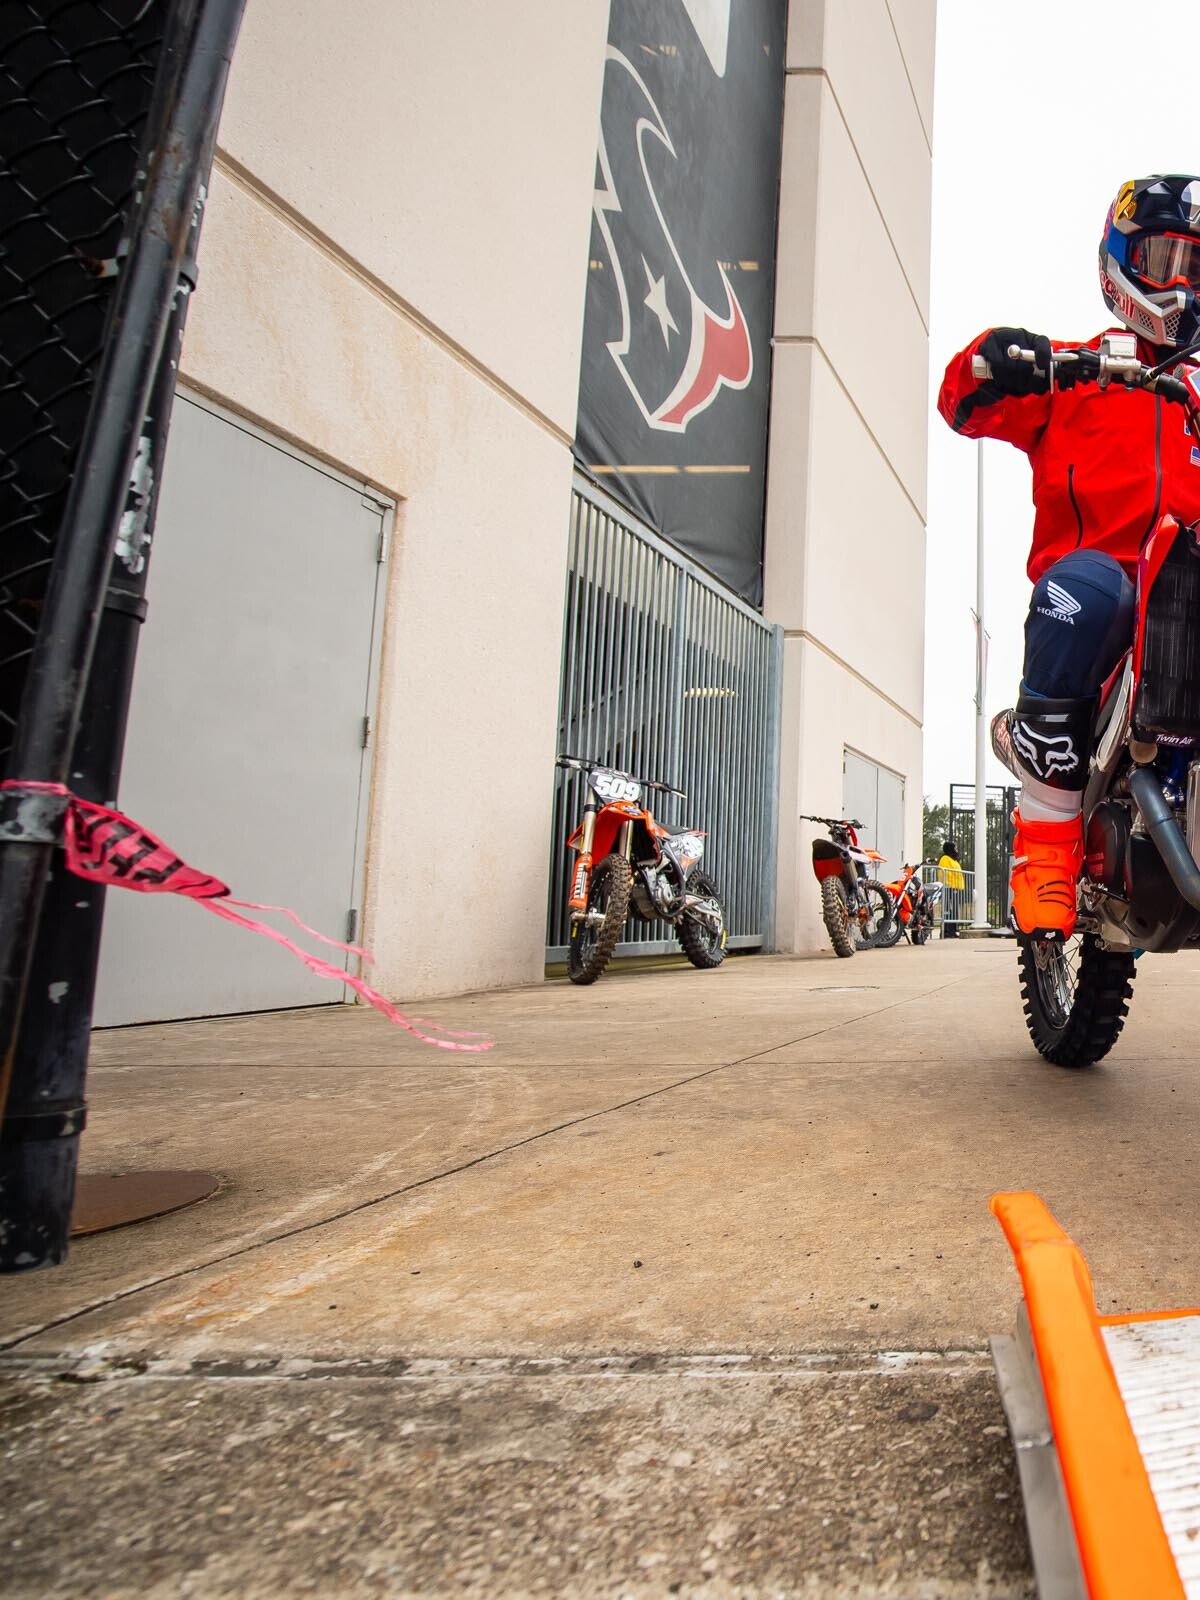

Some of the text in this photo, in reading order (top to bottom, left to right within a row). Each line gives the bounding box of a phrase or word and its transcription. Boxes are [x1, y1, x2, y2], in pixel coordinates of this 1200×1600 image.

[1036, 606, 1075, 626] HONDA
[1155, 733, 1194, 745] Twin Air
[594, 774, 640, 802] 509
